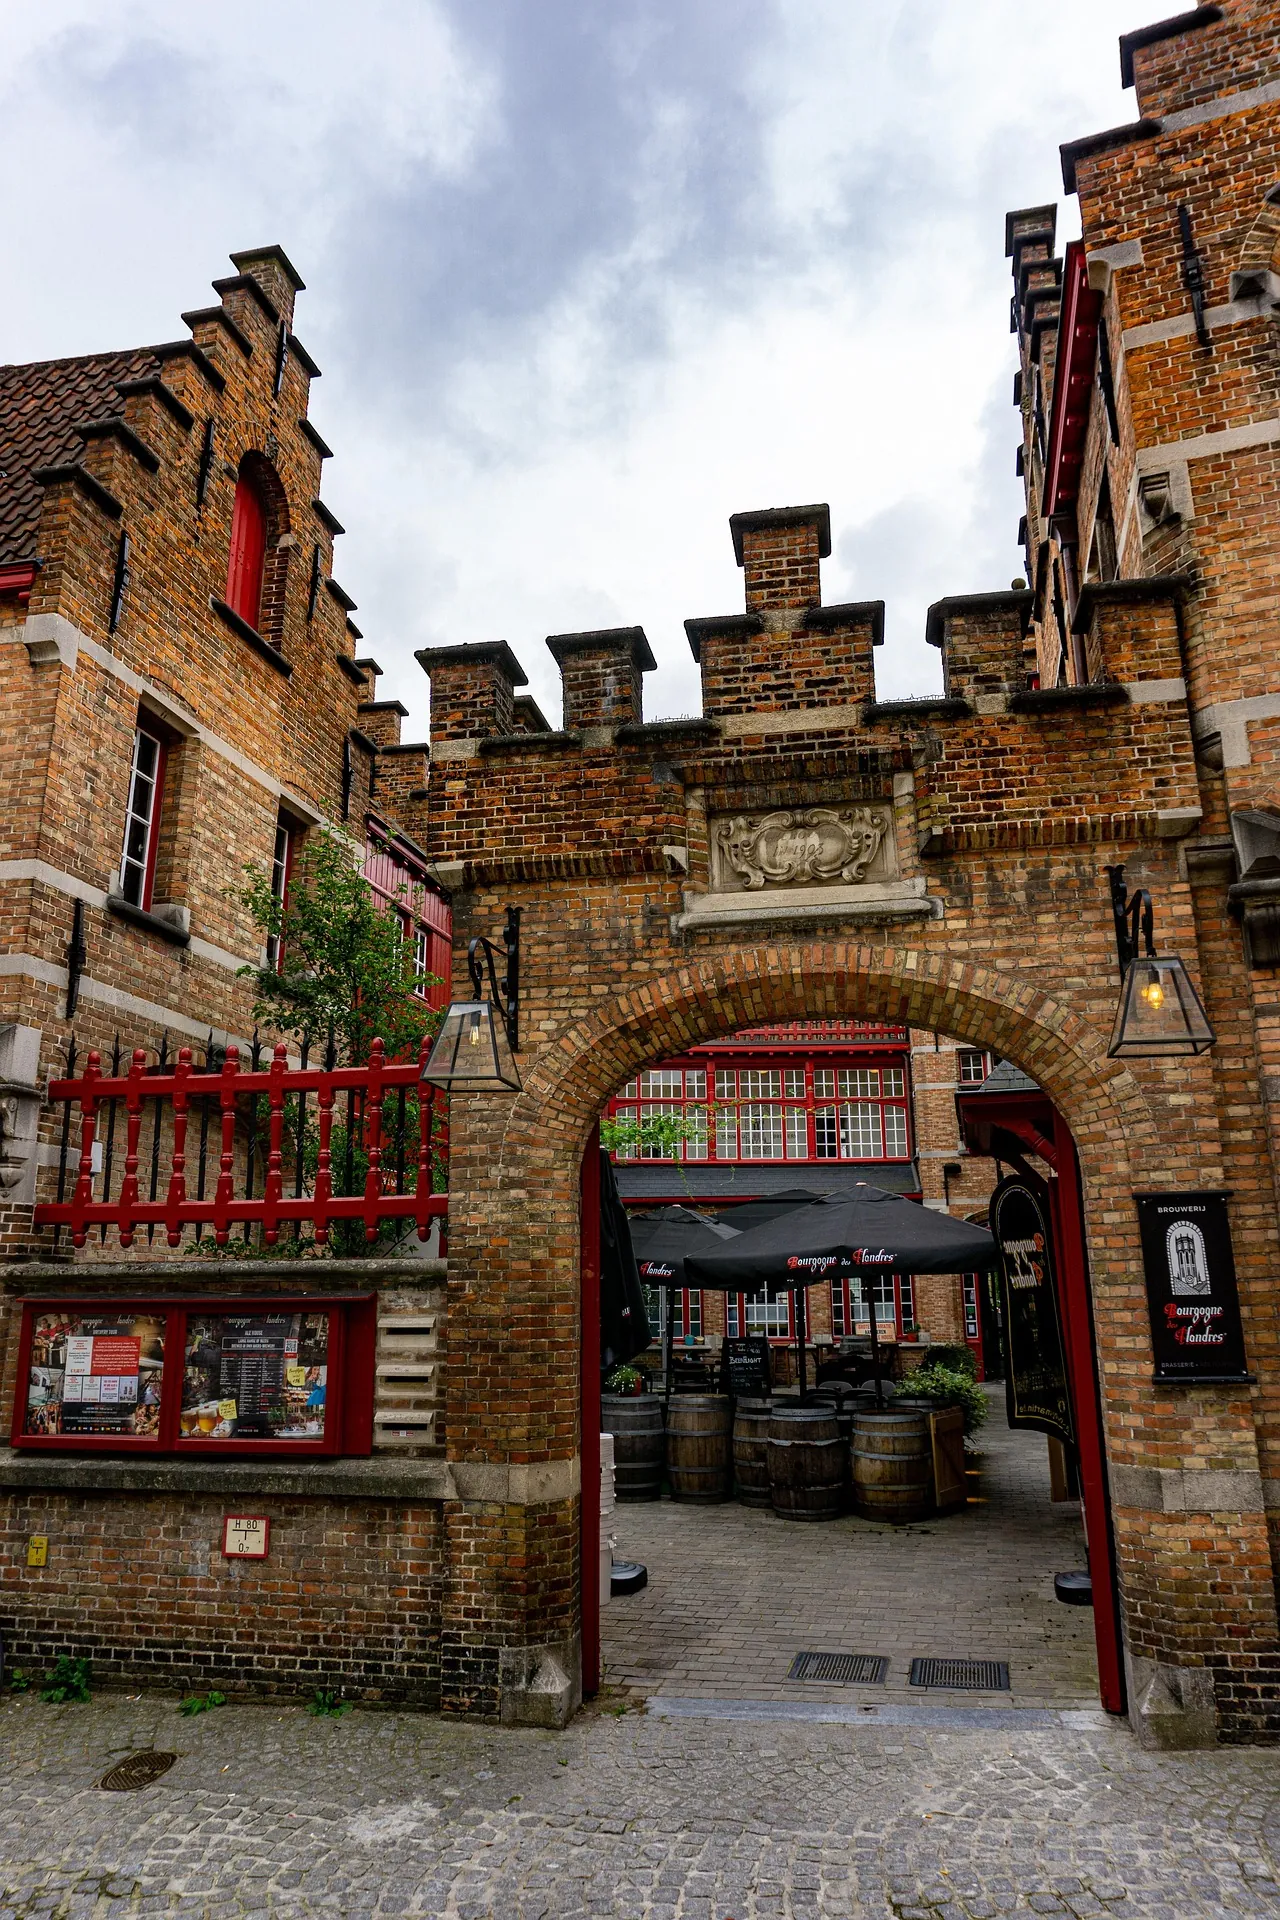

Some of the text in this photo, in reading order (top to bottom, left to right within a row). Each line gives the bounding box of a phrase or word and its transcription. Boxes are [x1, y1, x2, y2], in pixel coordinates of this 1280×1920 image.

[1157, 1206, 1206, 1214] BROUWERIJ
[640, 1262, 673, 1277] Flandres
[787, 1248, 894, 1274] Bourgogne des Flandres
[1163, 1302, 1224, 1324] Bourgogne
[1173, 1325, 1224, 1346] Flandres
[235, 1520, 240, 1528] H
[246, 1520, 257, 1529] 80
